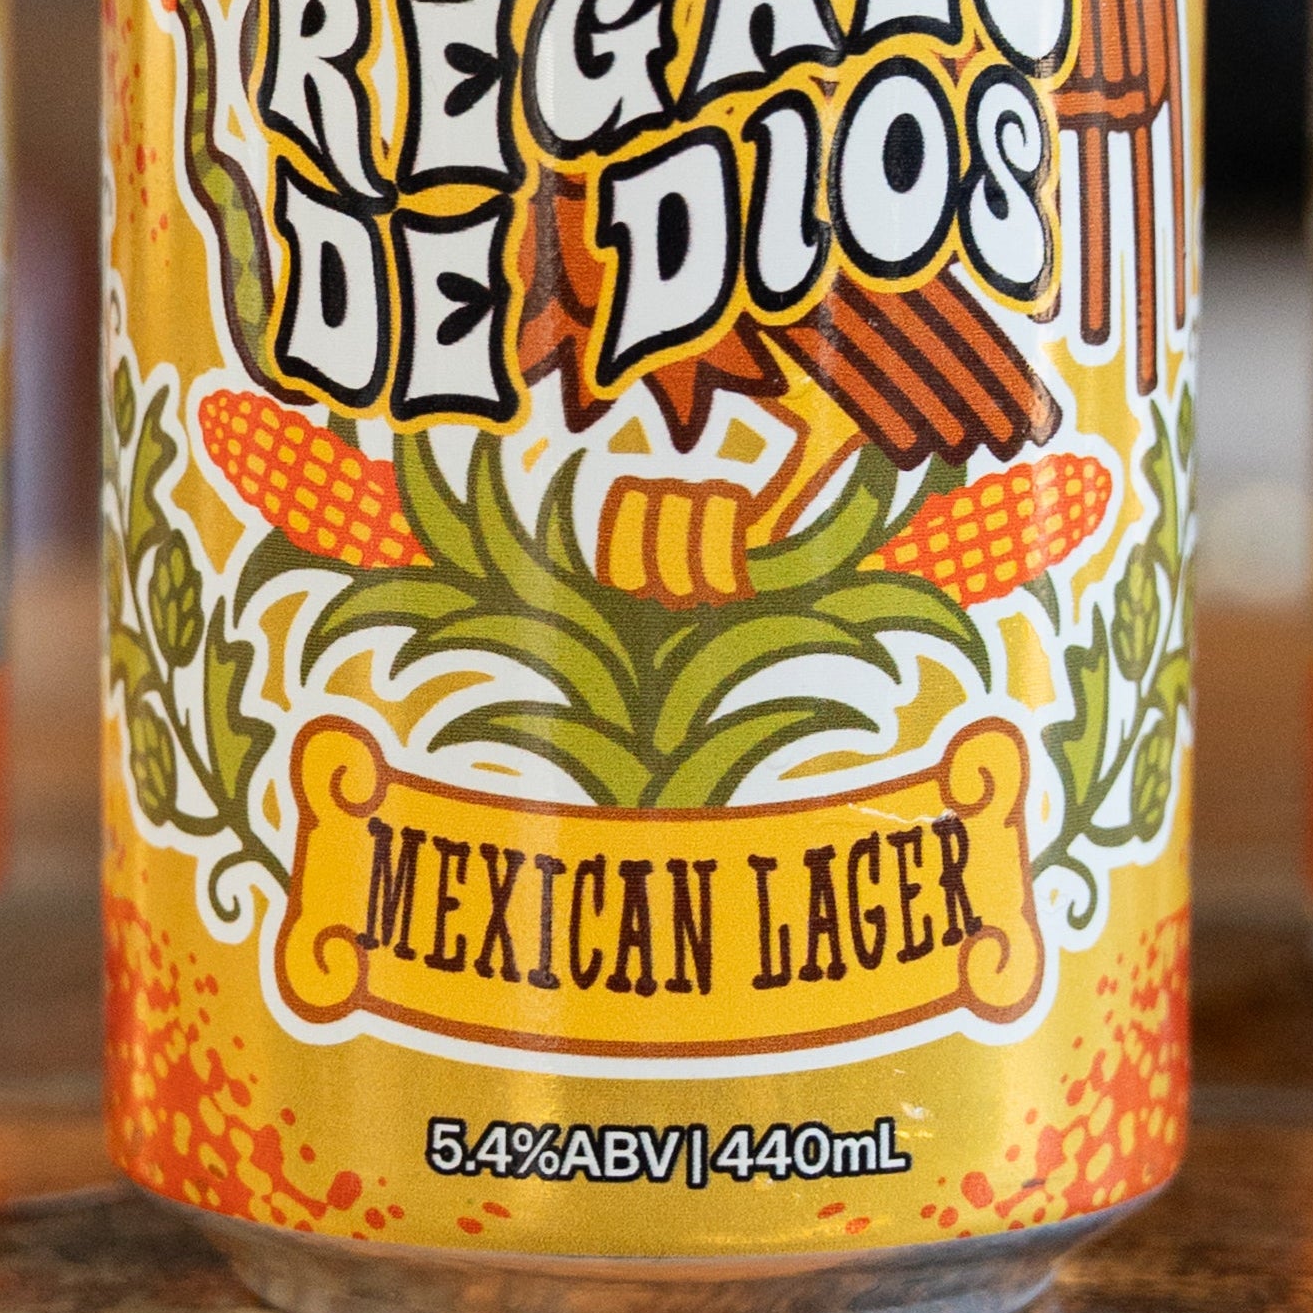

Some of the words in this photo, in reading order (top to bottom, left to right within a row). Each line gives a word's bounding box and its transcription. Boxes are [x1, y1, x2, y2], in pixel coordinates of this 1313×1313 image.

[275, 155, 520, 423] DE
[597, 55, 1053, 389] DIOS
[355, 816, 717, 996] MEXICAN
[747, 814, 984, 991] LAGER
